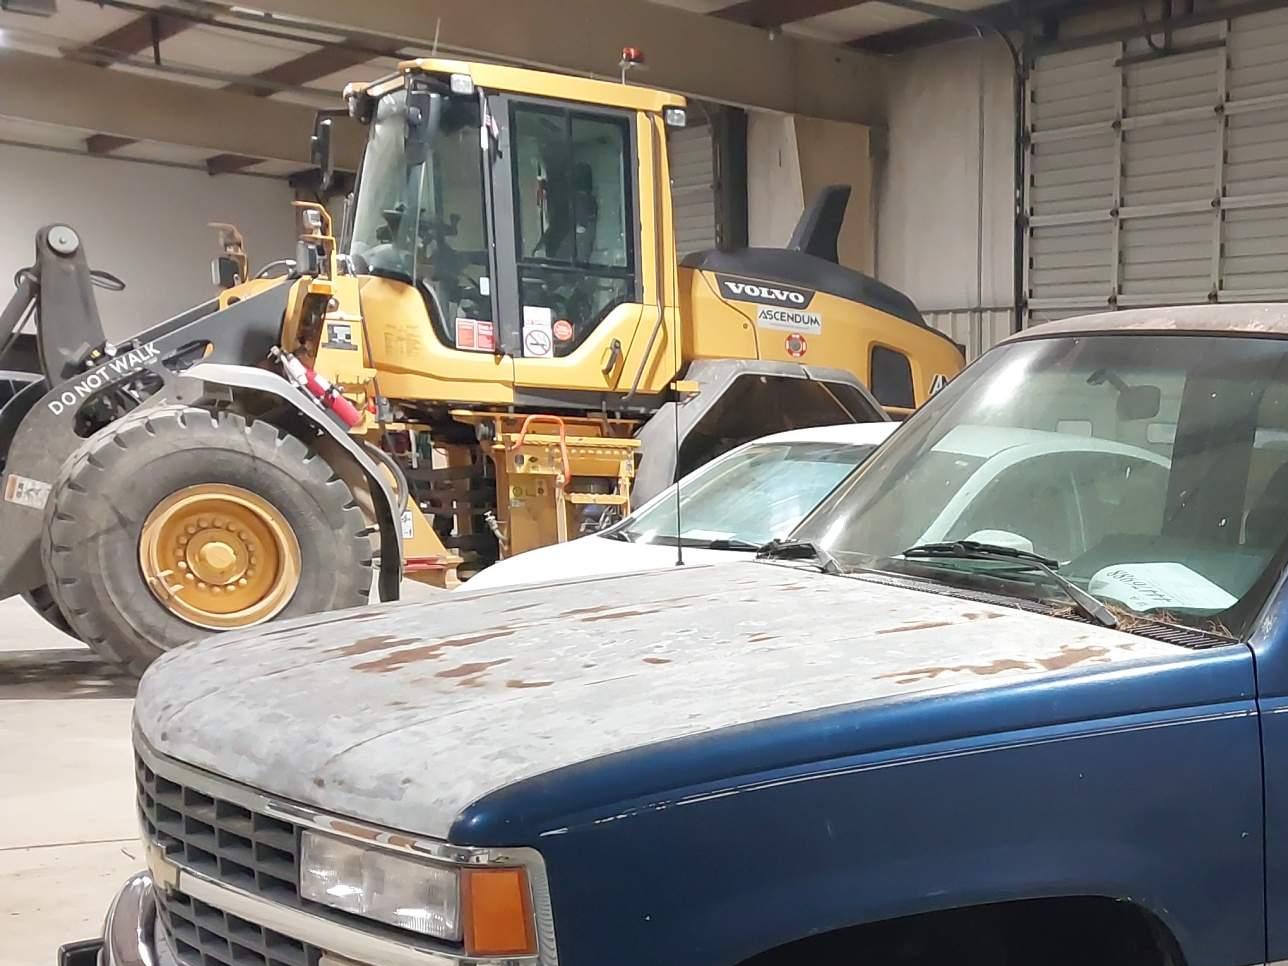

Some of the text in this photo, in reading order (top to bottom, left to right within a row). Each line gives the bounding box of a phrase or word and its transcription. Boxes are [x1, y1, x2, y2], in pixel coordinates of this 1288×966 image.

[724, 281, 804, 303] VOLVO
[758, 309, 820, 327] ASCENDUM
[48, 342, 160, 415] DO NOT WALK
